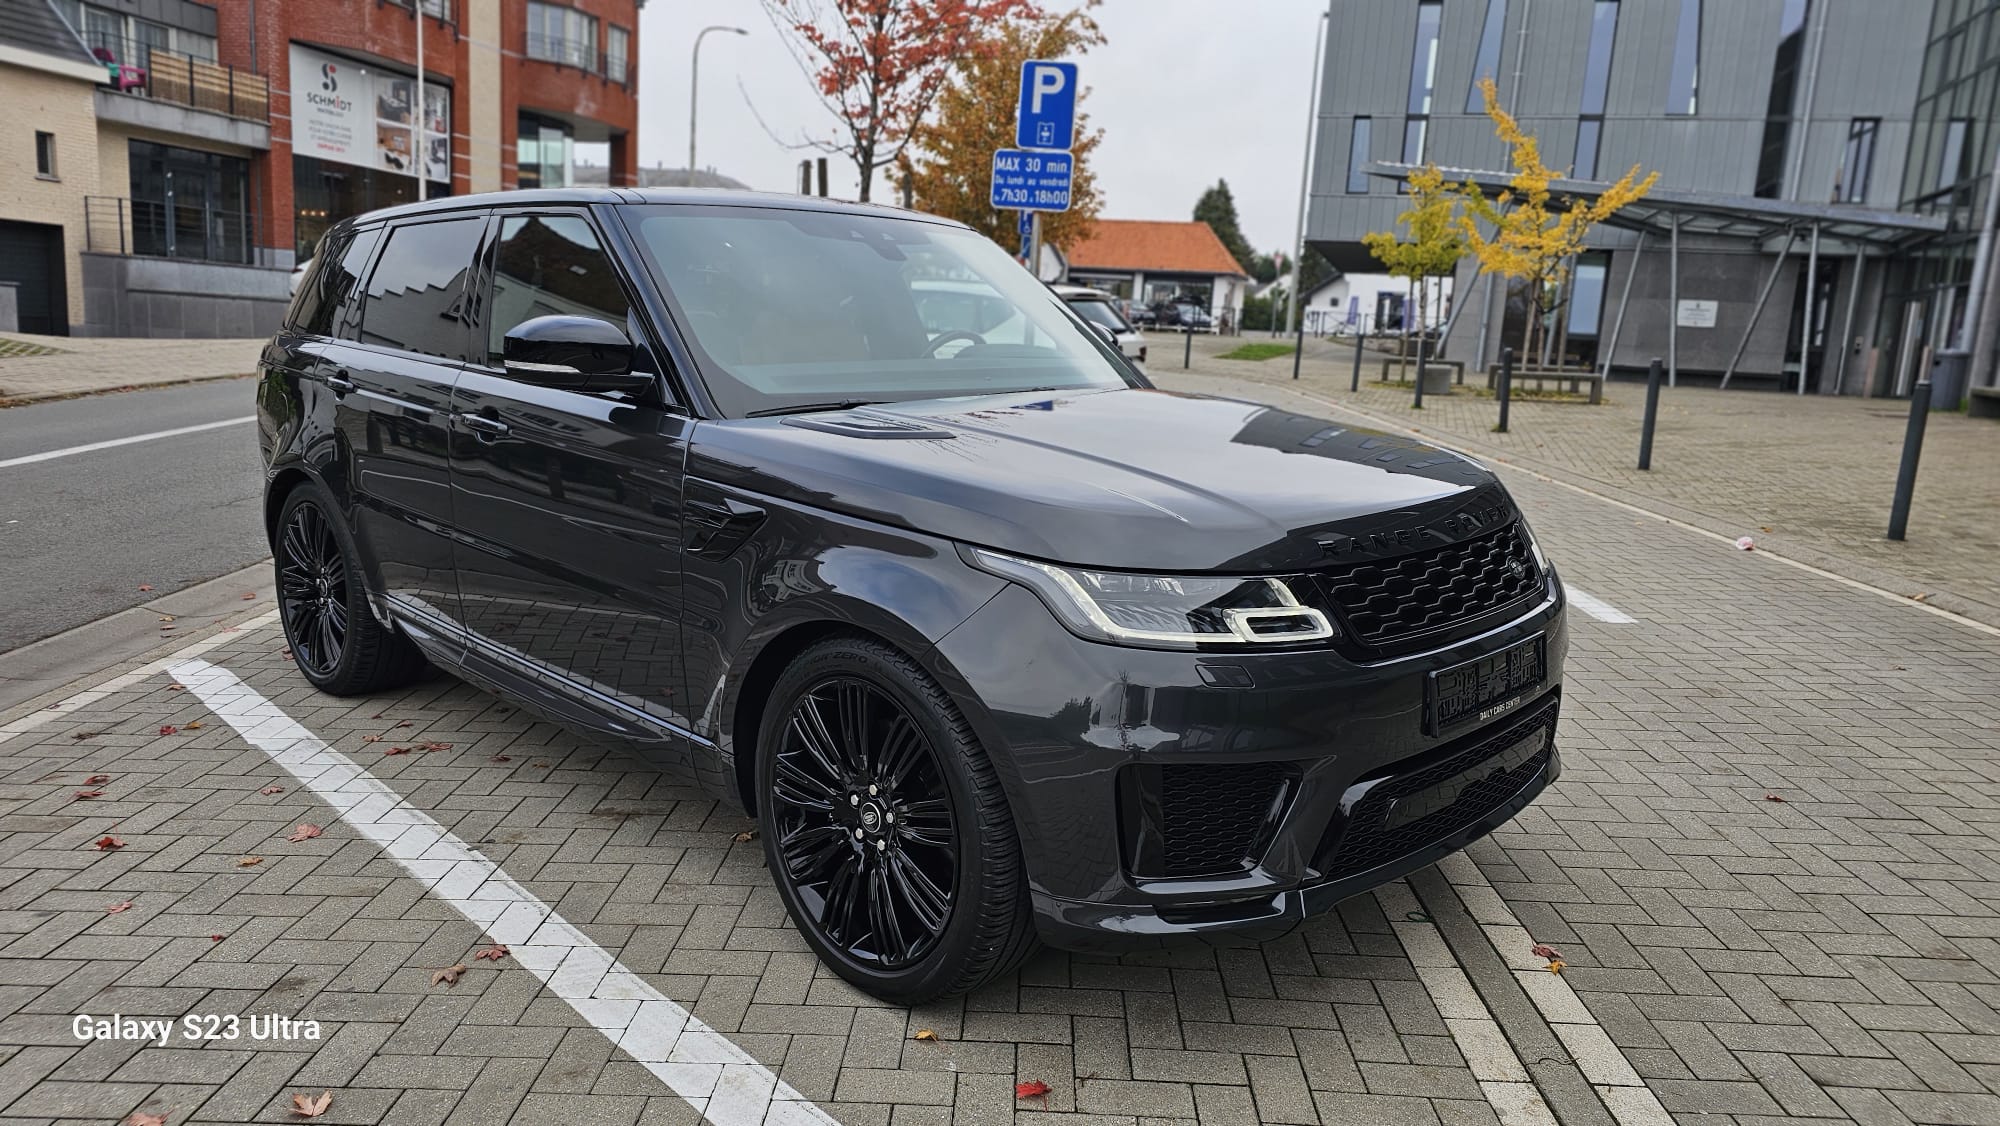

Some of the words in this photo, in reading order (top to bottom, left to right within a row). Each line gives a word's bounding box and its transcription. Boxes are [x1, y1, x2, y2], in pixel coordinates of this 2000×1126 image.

[1031, 65, 1065, 114] P
[996, 157, 1020, 172] MAX
[1025, 157, 1041, 172] 30
[1000, 188, 1028, 203] 7h30
[1034, 190, 1068, 204] 18h00
[1317, 525, 1430, 556] RANGE
[832, 651, 868, 664] ZERO
